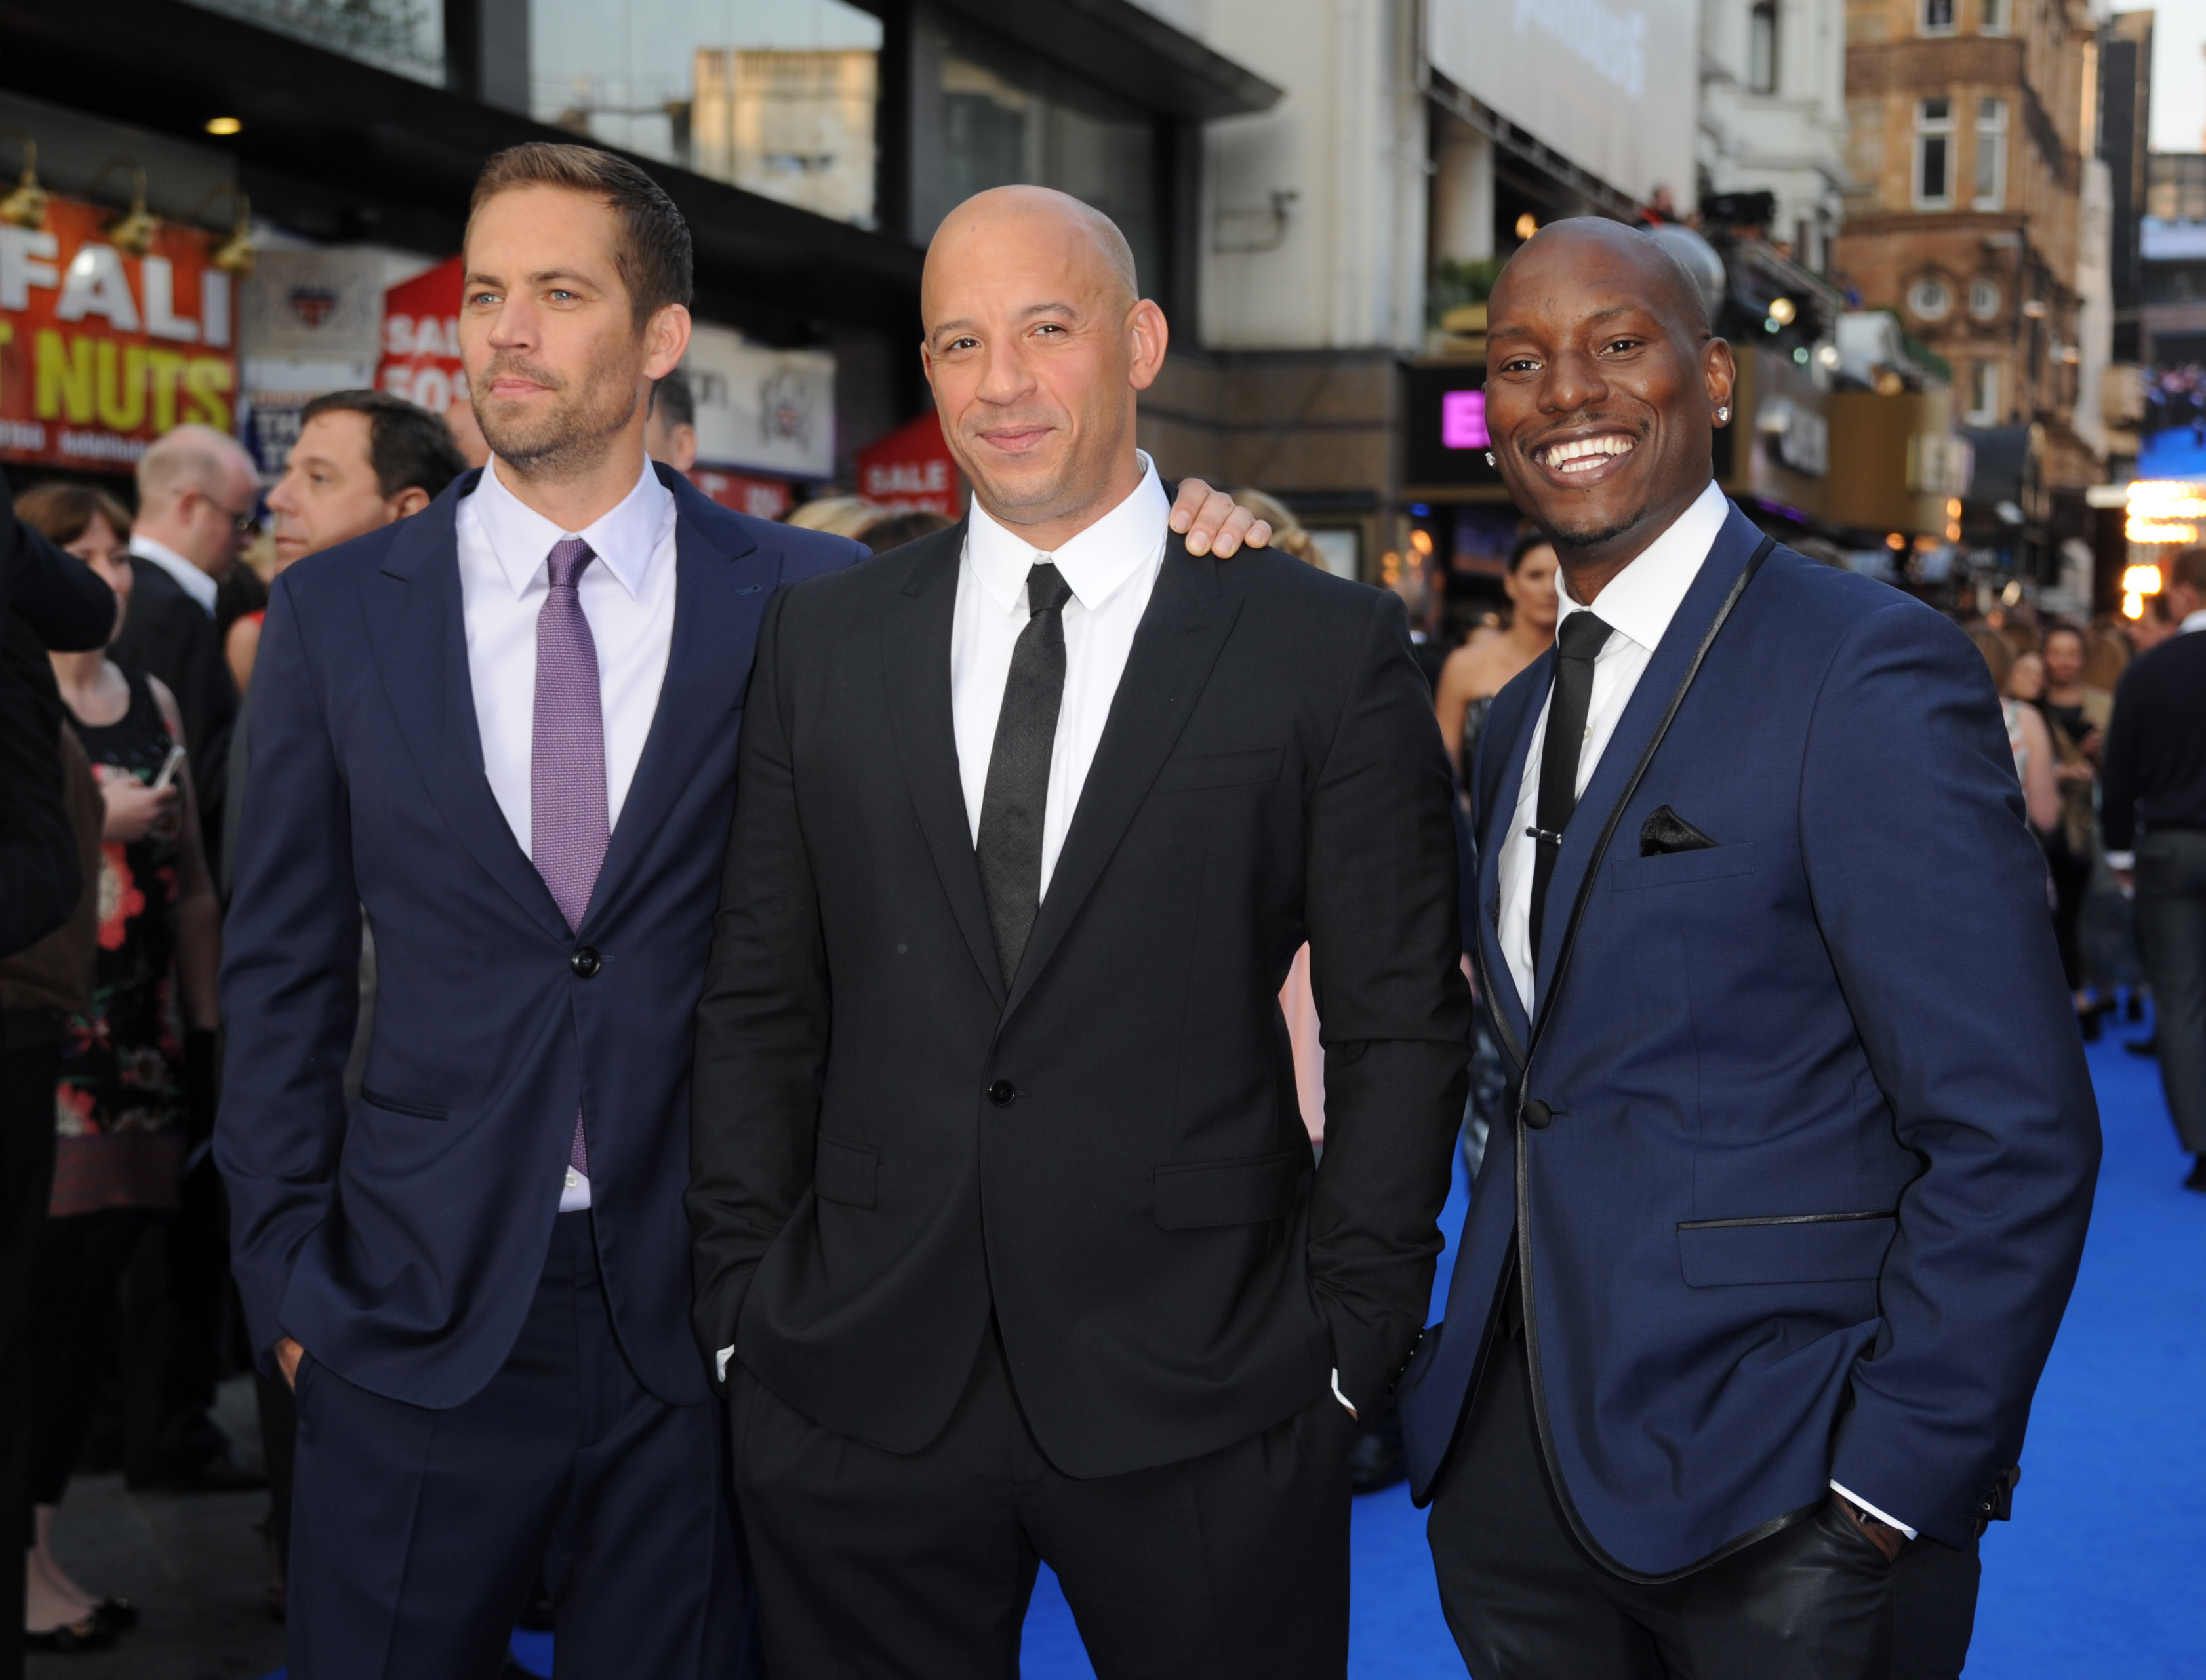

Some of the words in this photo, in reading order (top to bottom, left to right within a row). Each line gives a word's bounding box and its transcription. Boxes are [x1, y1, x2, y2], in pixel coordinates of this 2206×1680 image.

[387, 313, 461, 358] SAL
[36, 328, 231, 435] NUTS
[866, 460, 949, 496] SALE
